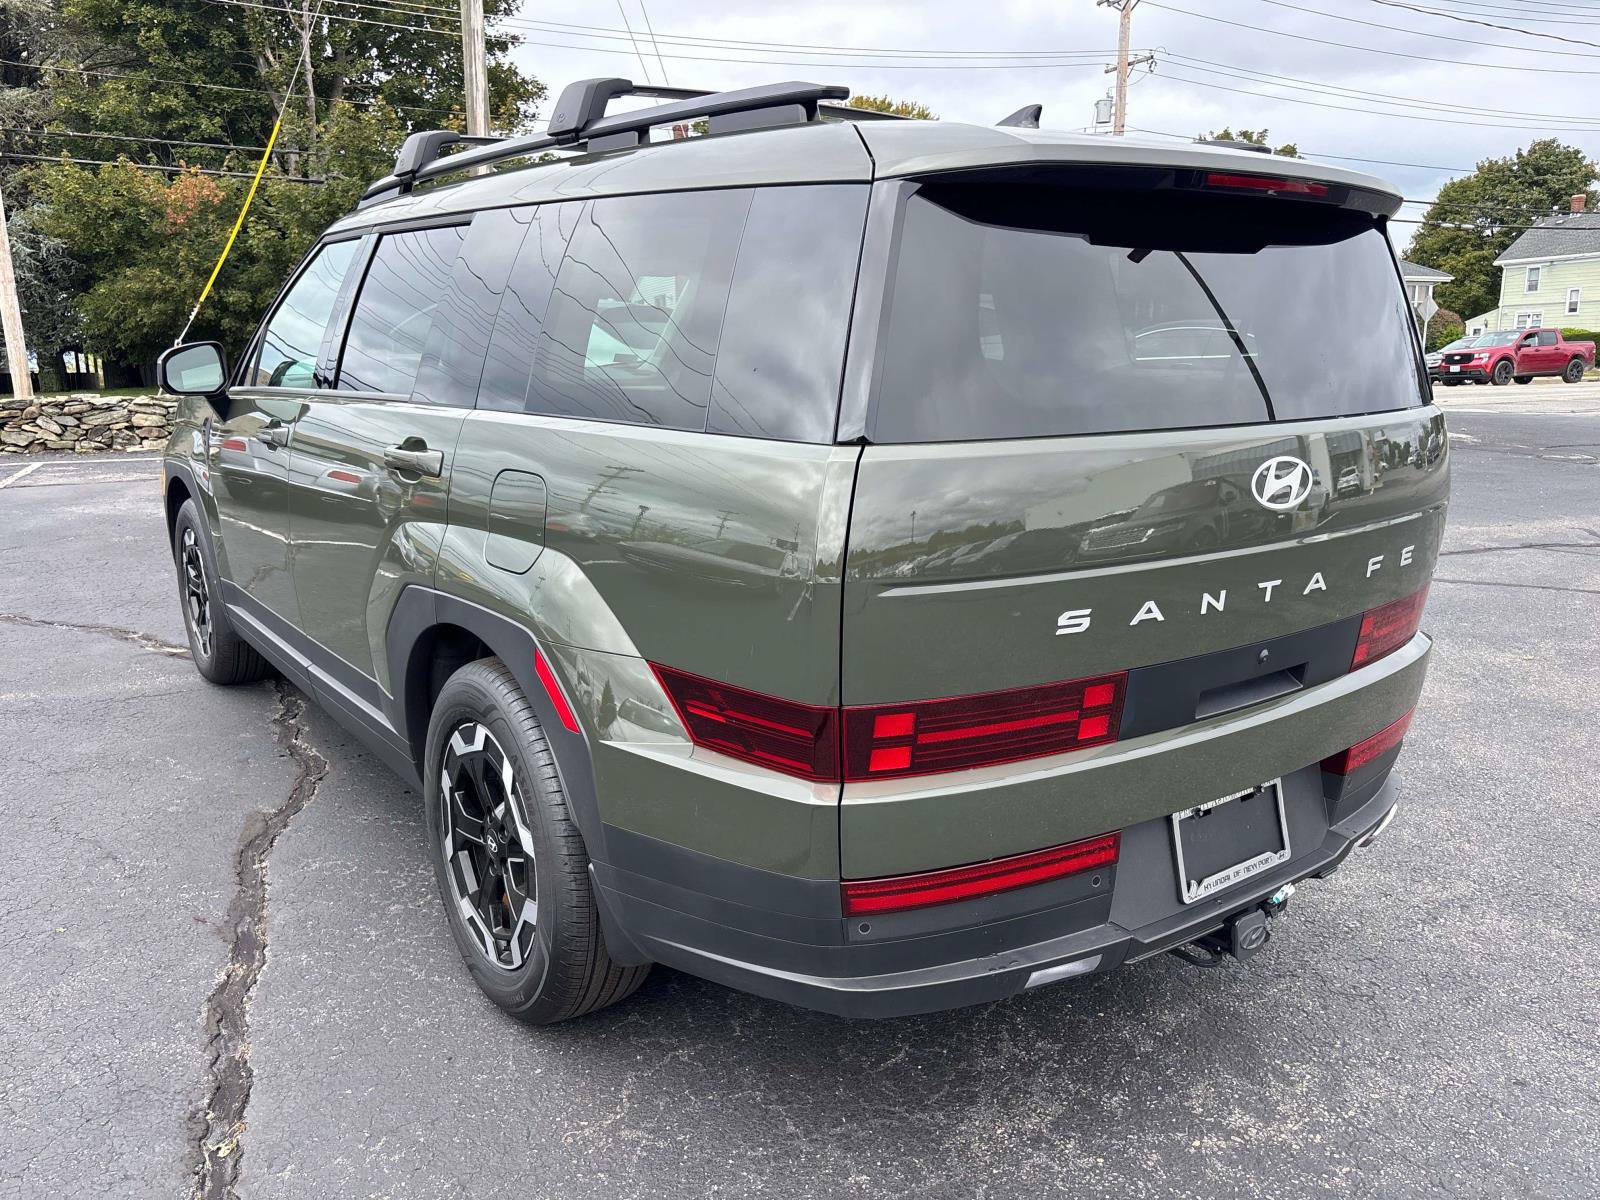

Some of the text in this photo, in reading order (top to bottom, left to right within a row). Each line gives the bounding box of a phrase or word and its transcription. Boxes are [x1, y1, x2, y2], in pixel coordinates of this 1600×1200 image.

[1055, 545, 1415, 635] SANTA FE
[1203, 876, 1231, 892] HYUNDAI
[1232, 869, 1242, 879] OF
